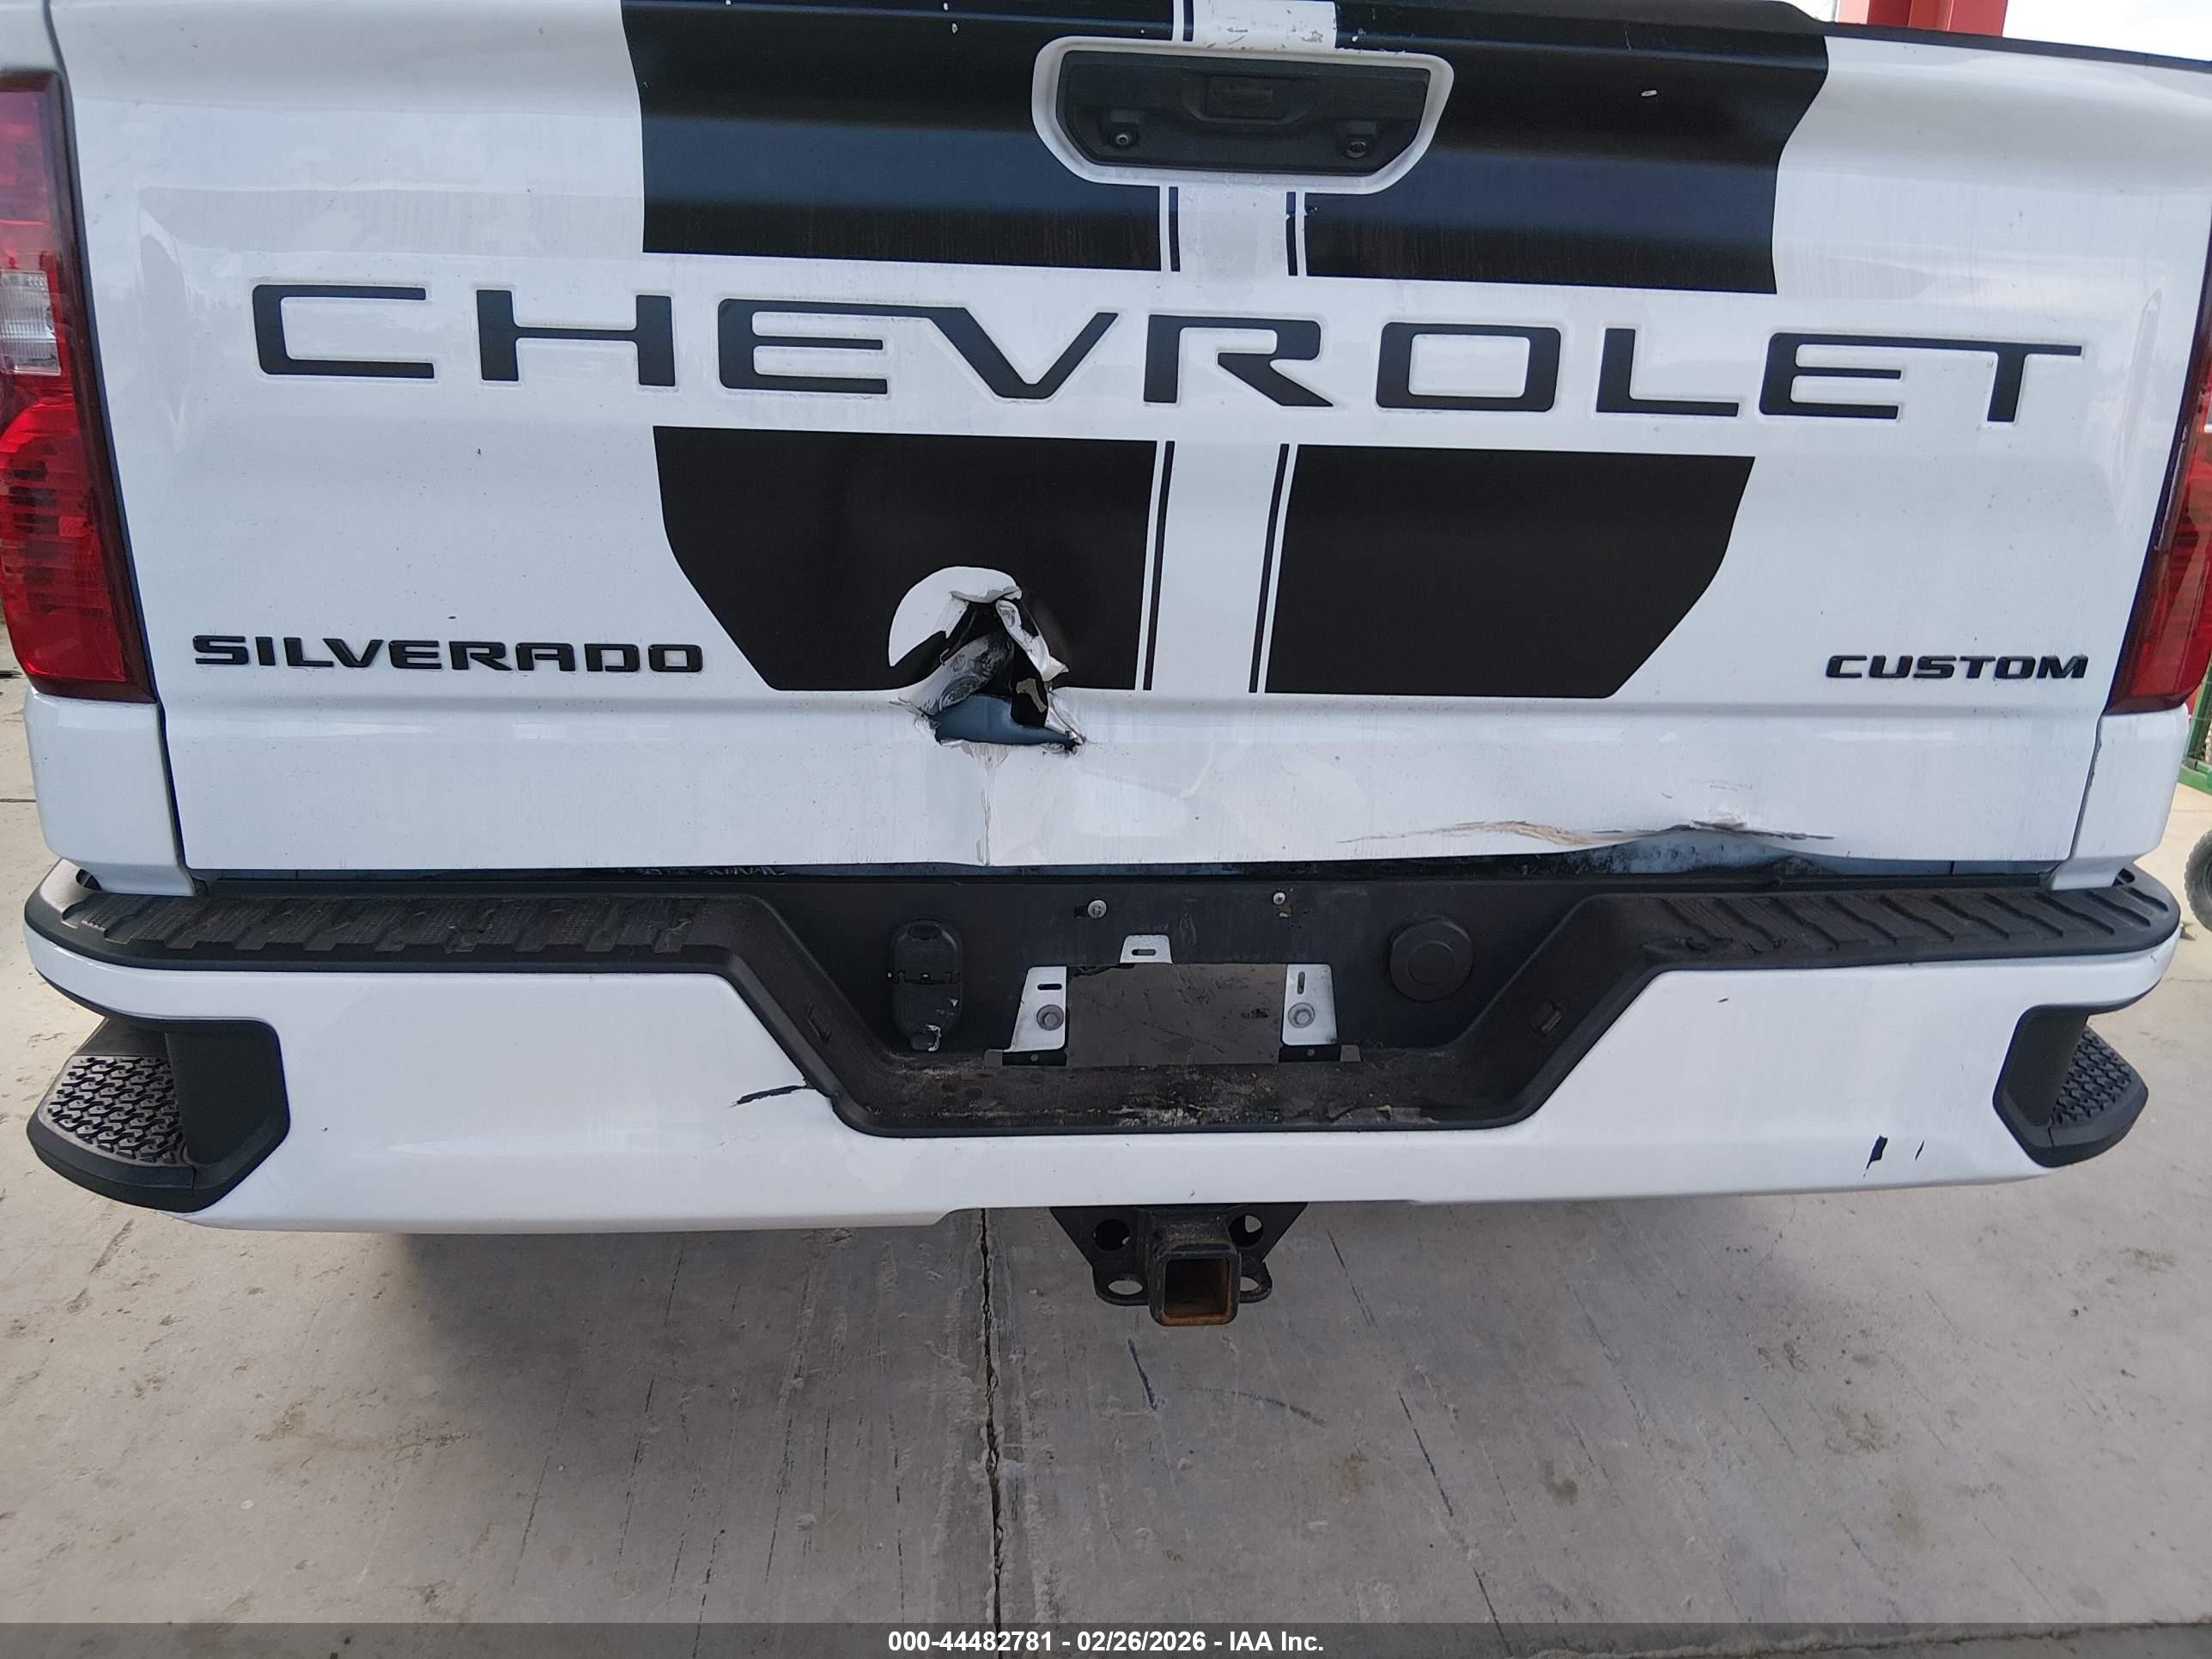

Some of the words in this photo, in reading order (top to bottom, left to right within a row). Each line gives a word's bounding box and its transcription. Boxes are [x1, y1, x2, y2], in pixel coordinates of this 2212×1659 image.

[252, 284, 2083, 423] CHEVROLET
[192, 635, 704, 673] SILVERADO
[1826, 655, 2089, 679] CUSTOM
